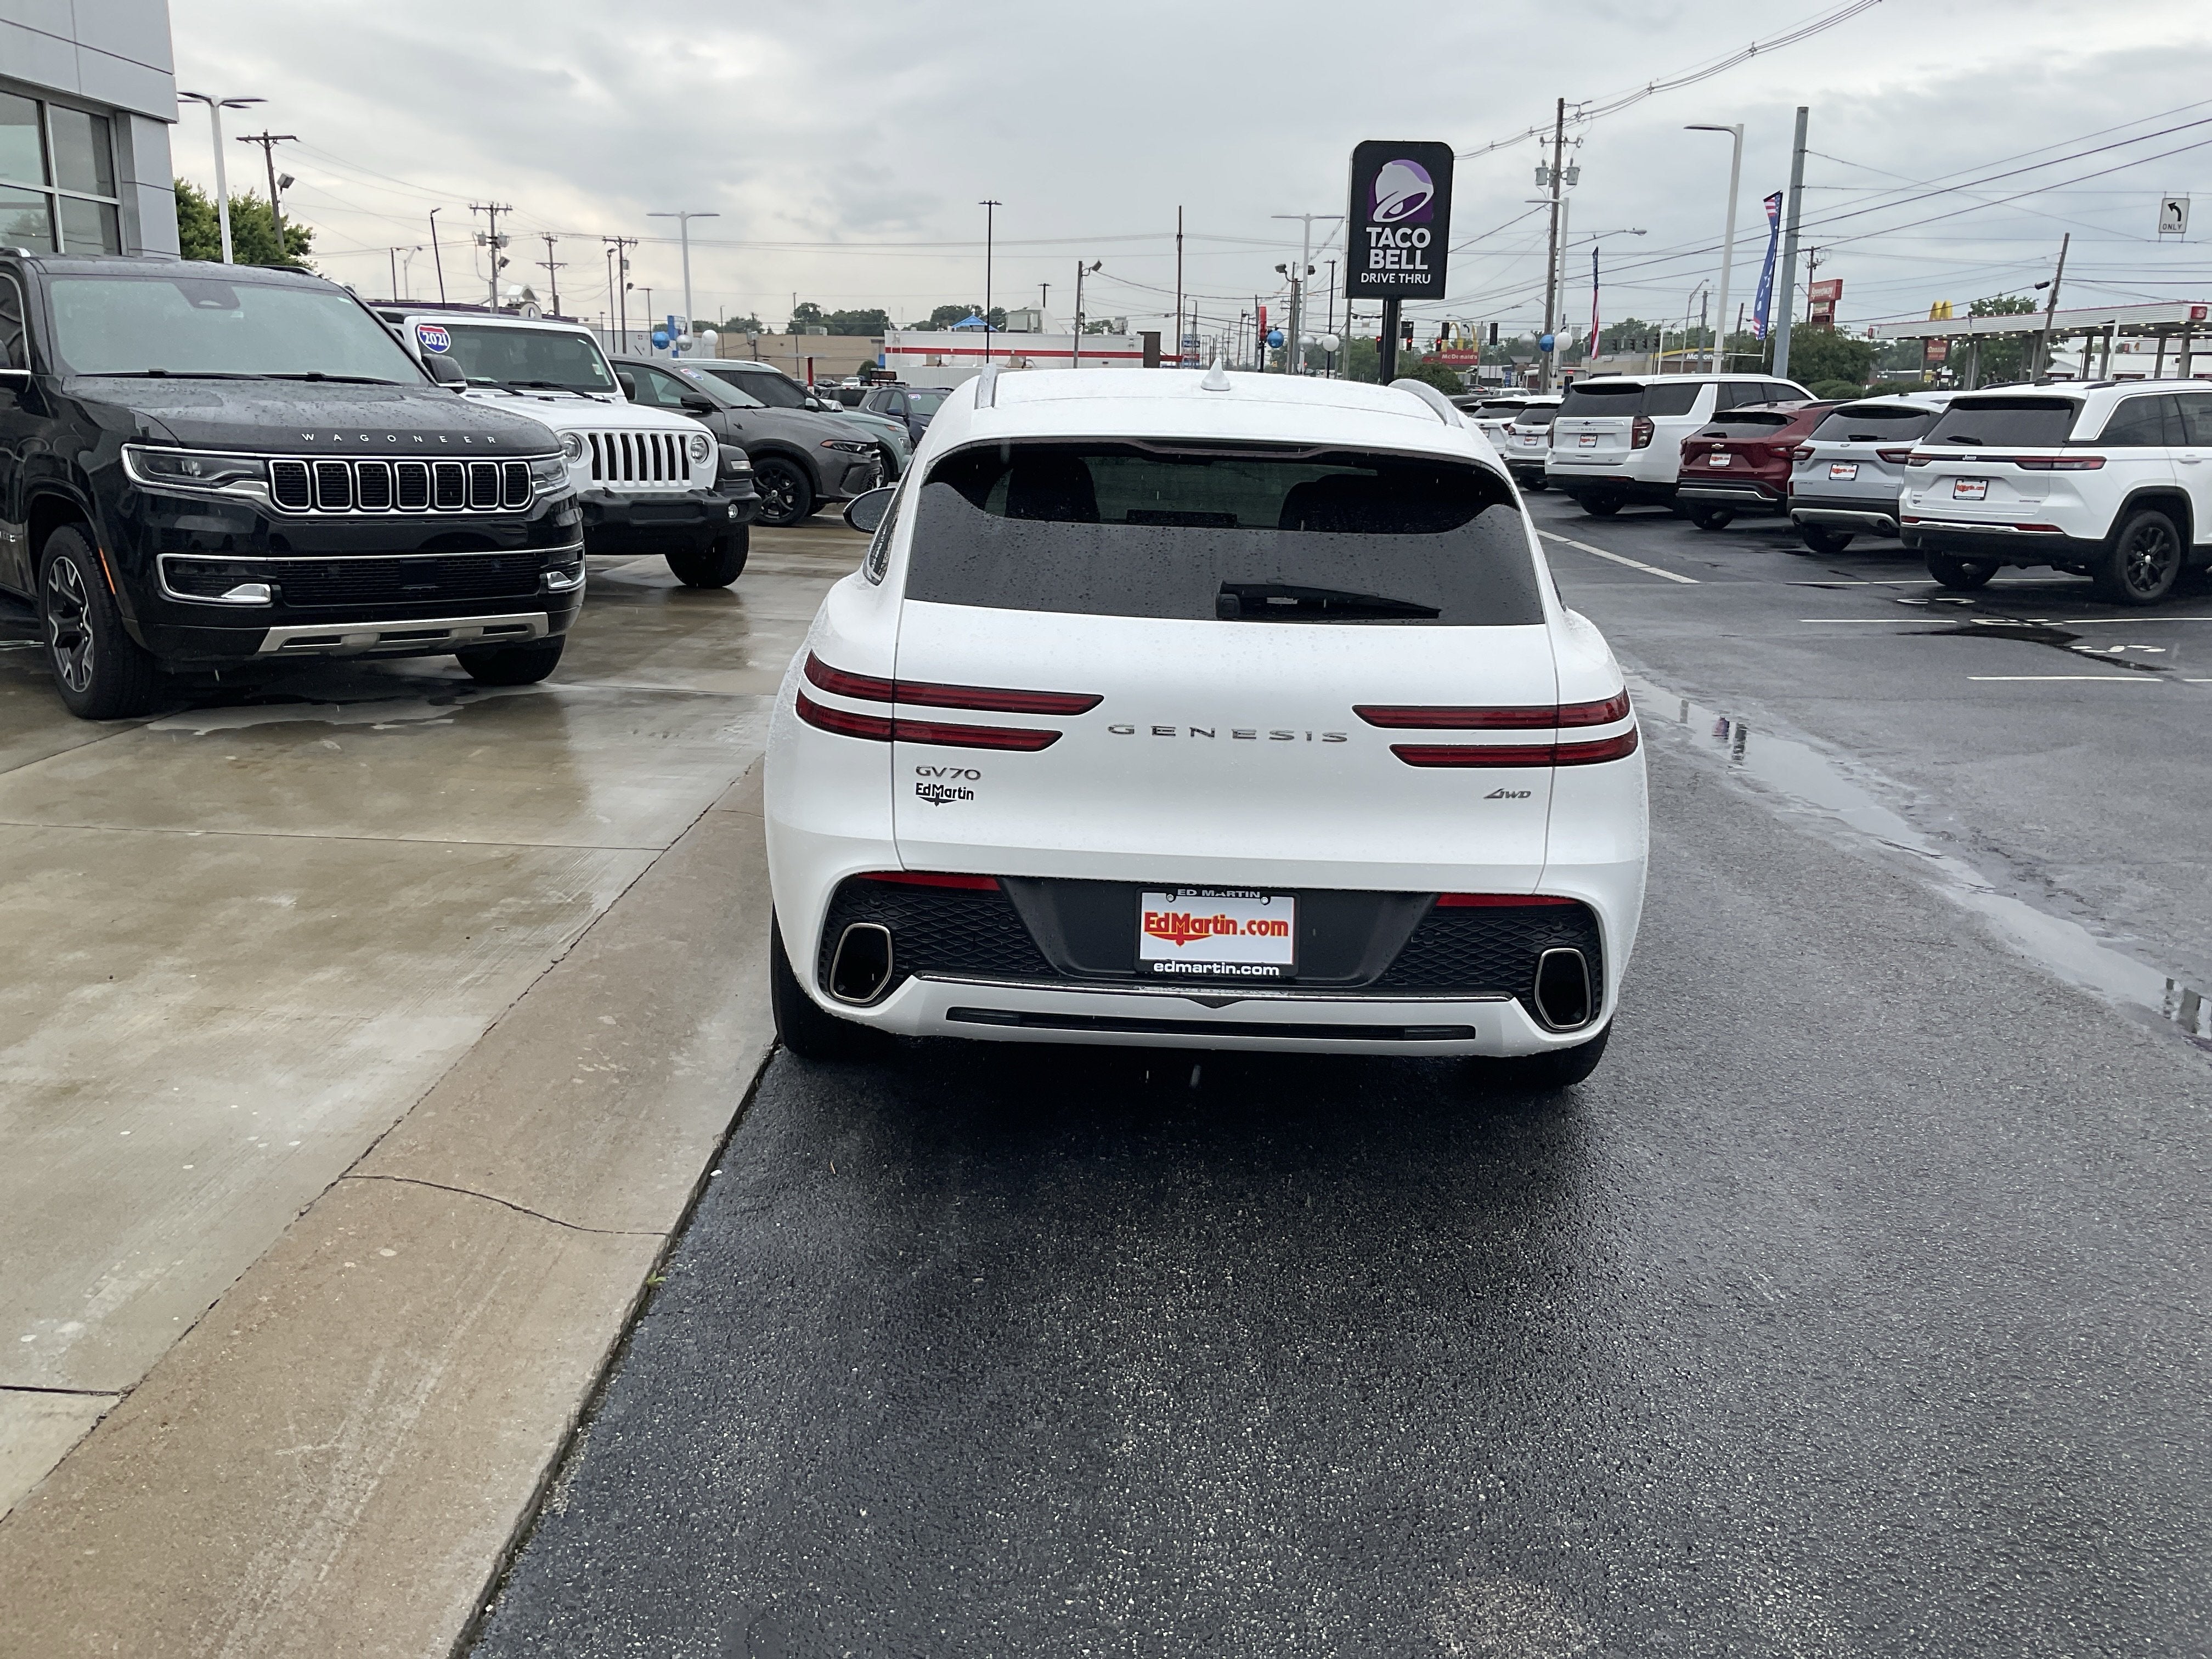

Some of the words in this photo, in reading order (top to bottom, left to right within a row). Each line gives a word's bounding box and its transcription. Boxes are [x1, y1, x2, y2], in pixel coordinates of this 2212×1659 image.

[1365, 227, 1431, 248] TACO
[1369, 249, 1429, 269] BELL
[1361, 273, 1396, 283] DRIVE
[1398, 273, 1431, 284] THRU
[422, 332, 448, 347] 2021
[302, 433, 496, 444] WAGONEER
[1107, 724, 1348, 742] GENESIS
[916, 765, 981, 780] GV70
[916, 782, 974, 800] EdMartin
[1202, 890, 1260, 898] MARTIN
[1144, 911, 1288, 936] EdMartin.com
[1154, 961, 1279, 975] edmartin.com
